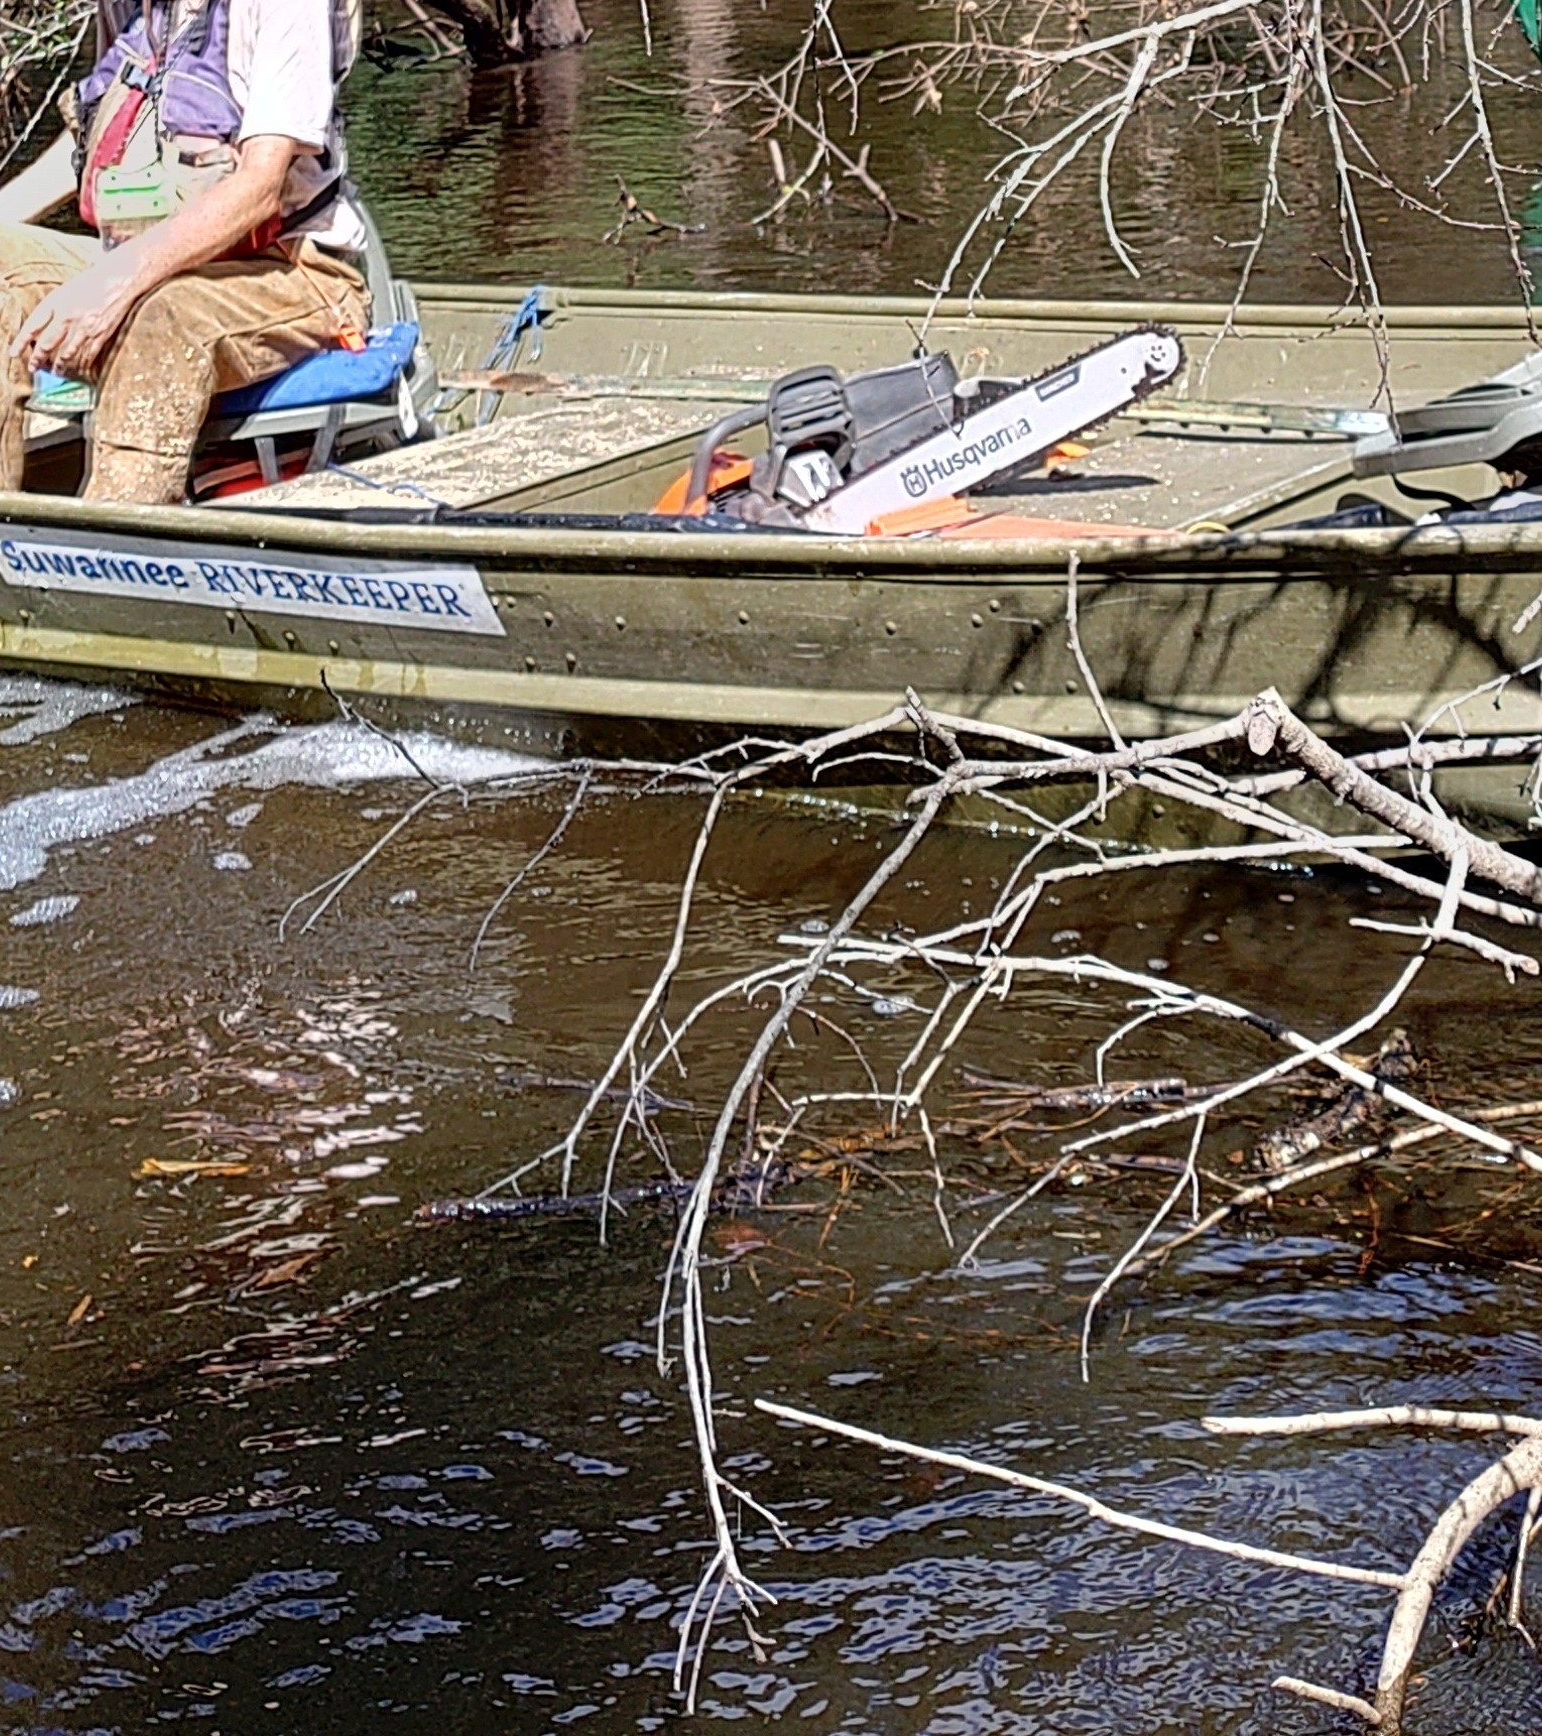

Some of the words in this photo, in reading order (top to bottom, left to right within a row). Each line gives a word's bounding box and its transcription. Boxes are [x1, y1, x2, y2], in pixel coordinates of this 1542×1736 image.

[922, 417, 1033, 485] Husqvarna
[0, 539, 190, 589] Suwannee
[195, 561, 472, 617] RIVERKEEPER
